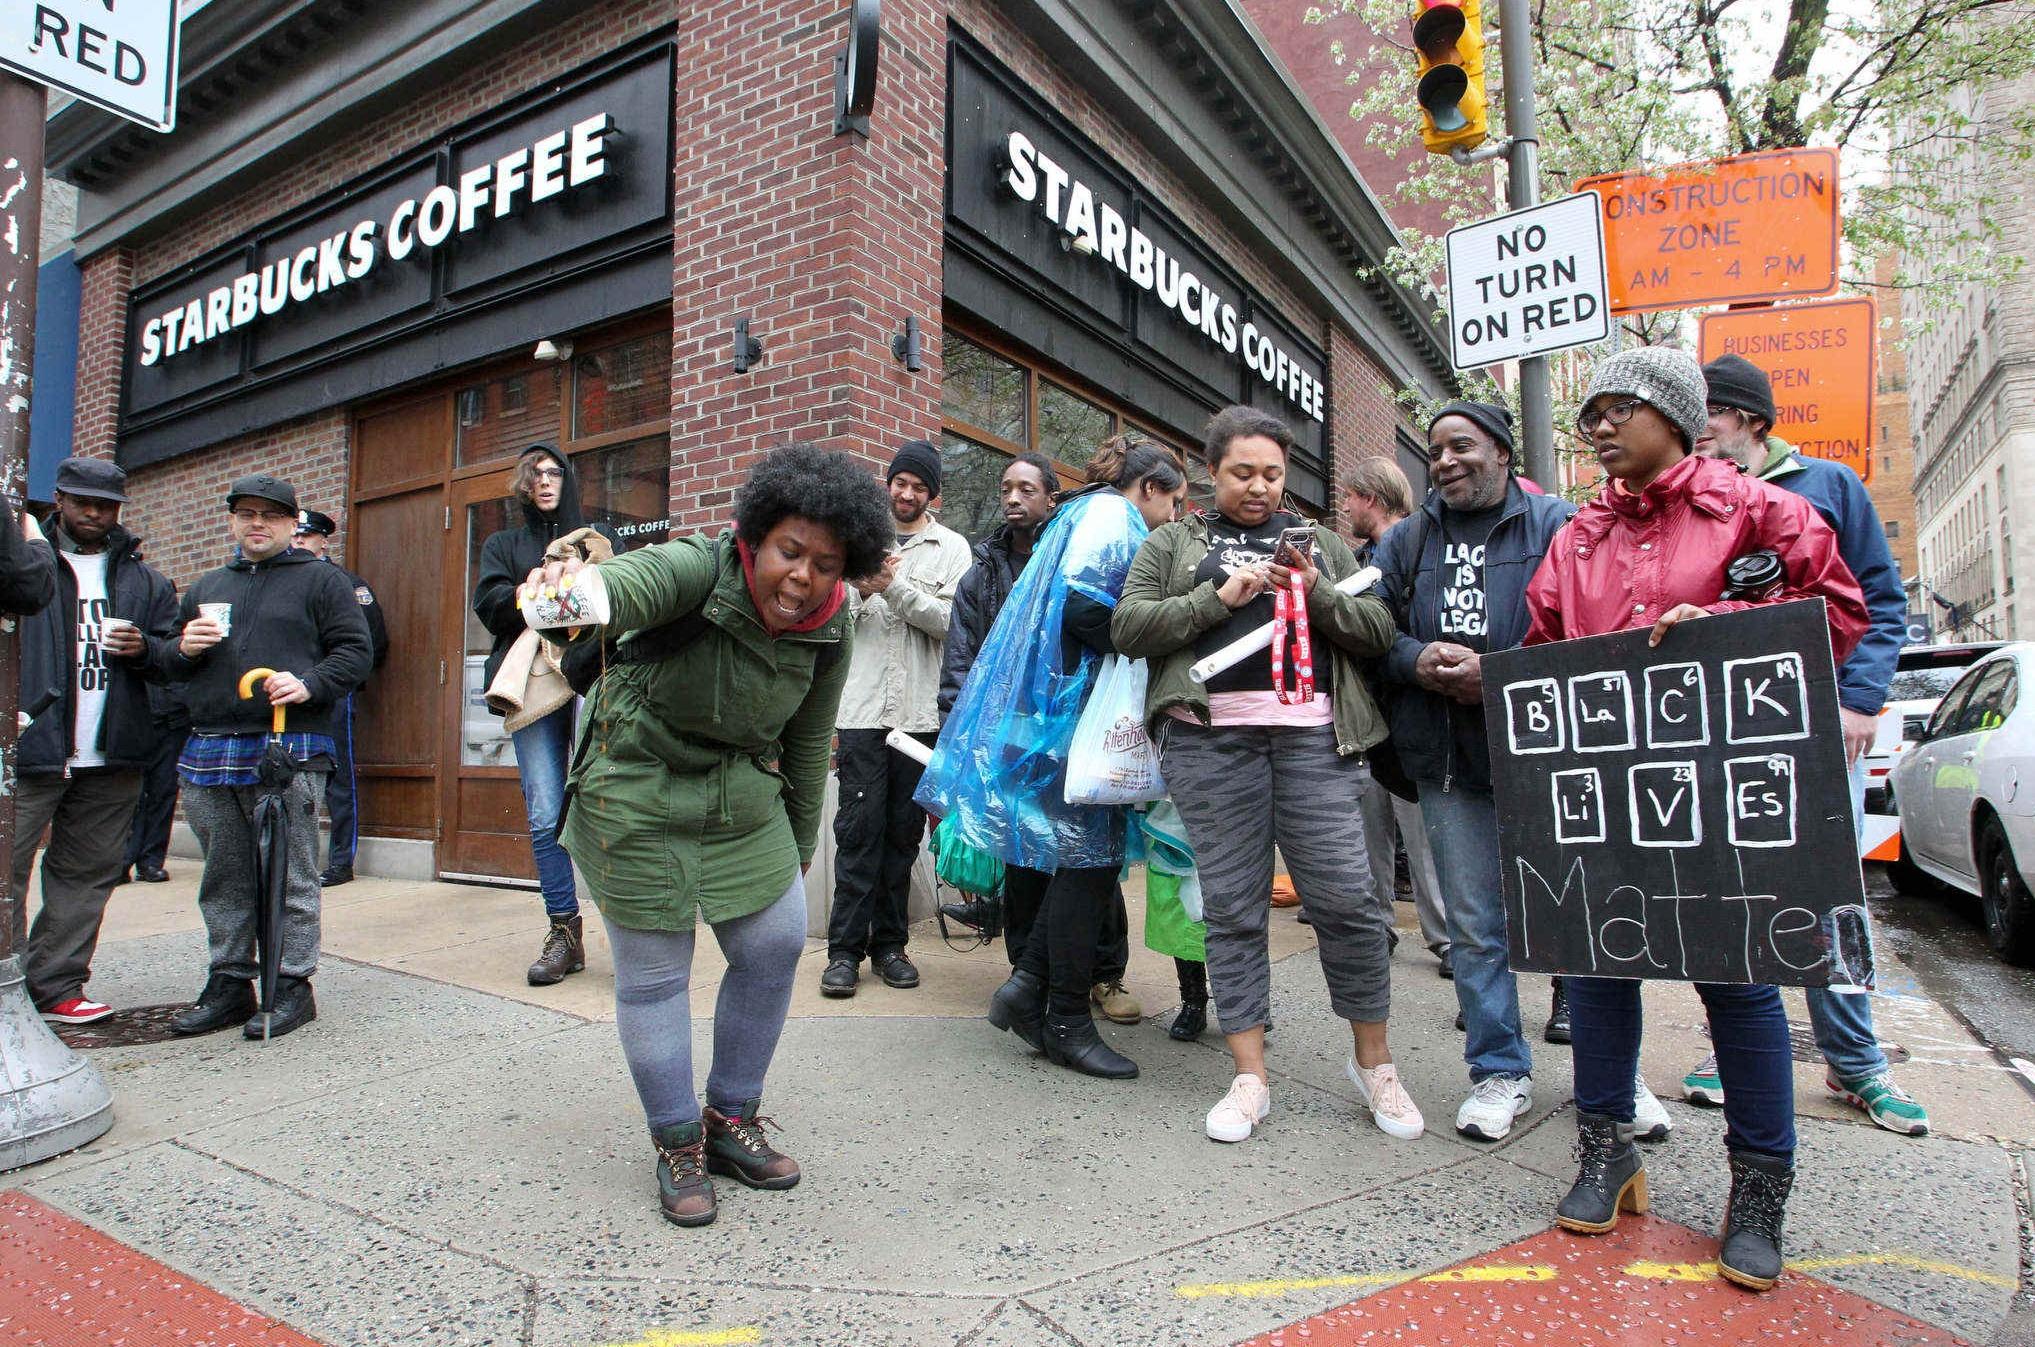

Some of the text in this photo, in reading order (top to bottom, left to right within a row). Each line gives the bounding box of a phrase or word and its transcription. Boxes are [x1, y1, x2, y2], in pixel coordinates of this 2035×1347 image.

[34, 4, 147, 86] RED
[1605, 171, 1824, 220] ONSTRUCTION
[140, 112, 608, 367] STARBUCKS COFFEE
[1496, 224, 1547, 261] NO
[1658, 219, 1742, 253] ZONE
[1007, 130, 1324, 424] STARBUCKS COFFEE
[1474, 255, 1577, 304] TURN
[1629, 267, 1671, 290] AM
[1725, 259, 1742, 280] 4
[1764, 253, 1807, 277] PM
[1461, 292, 1597, 346] ON RED
[1723, 327, 1849, 355] BUSINESSES
[1796, 438, 1860, 460] CTION
[614, 524, 637, 536] CKS
[1454, 563, 1477, 587] IS
[1443, 586, 1486, 611] NOT
